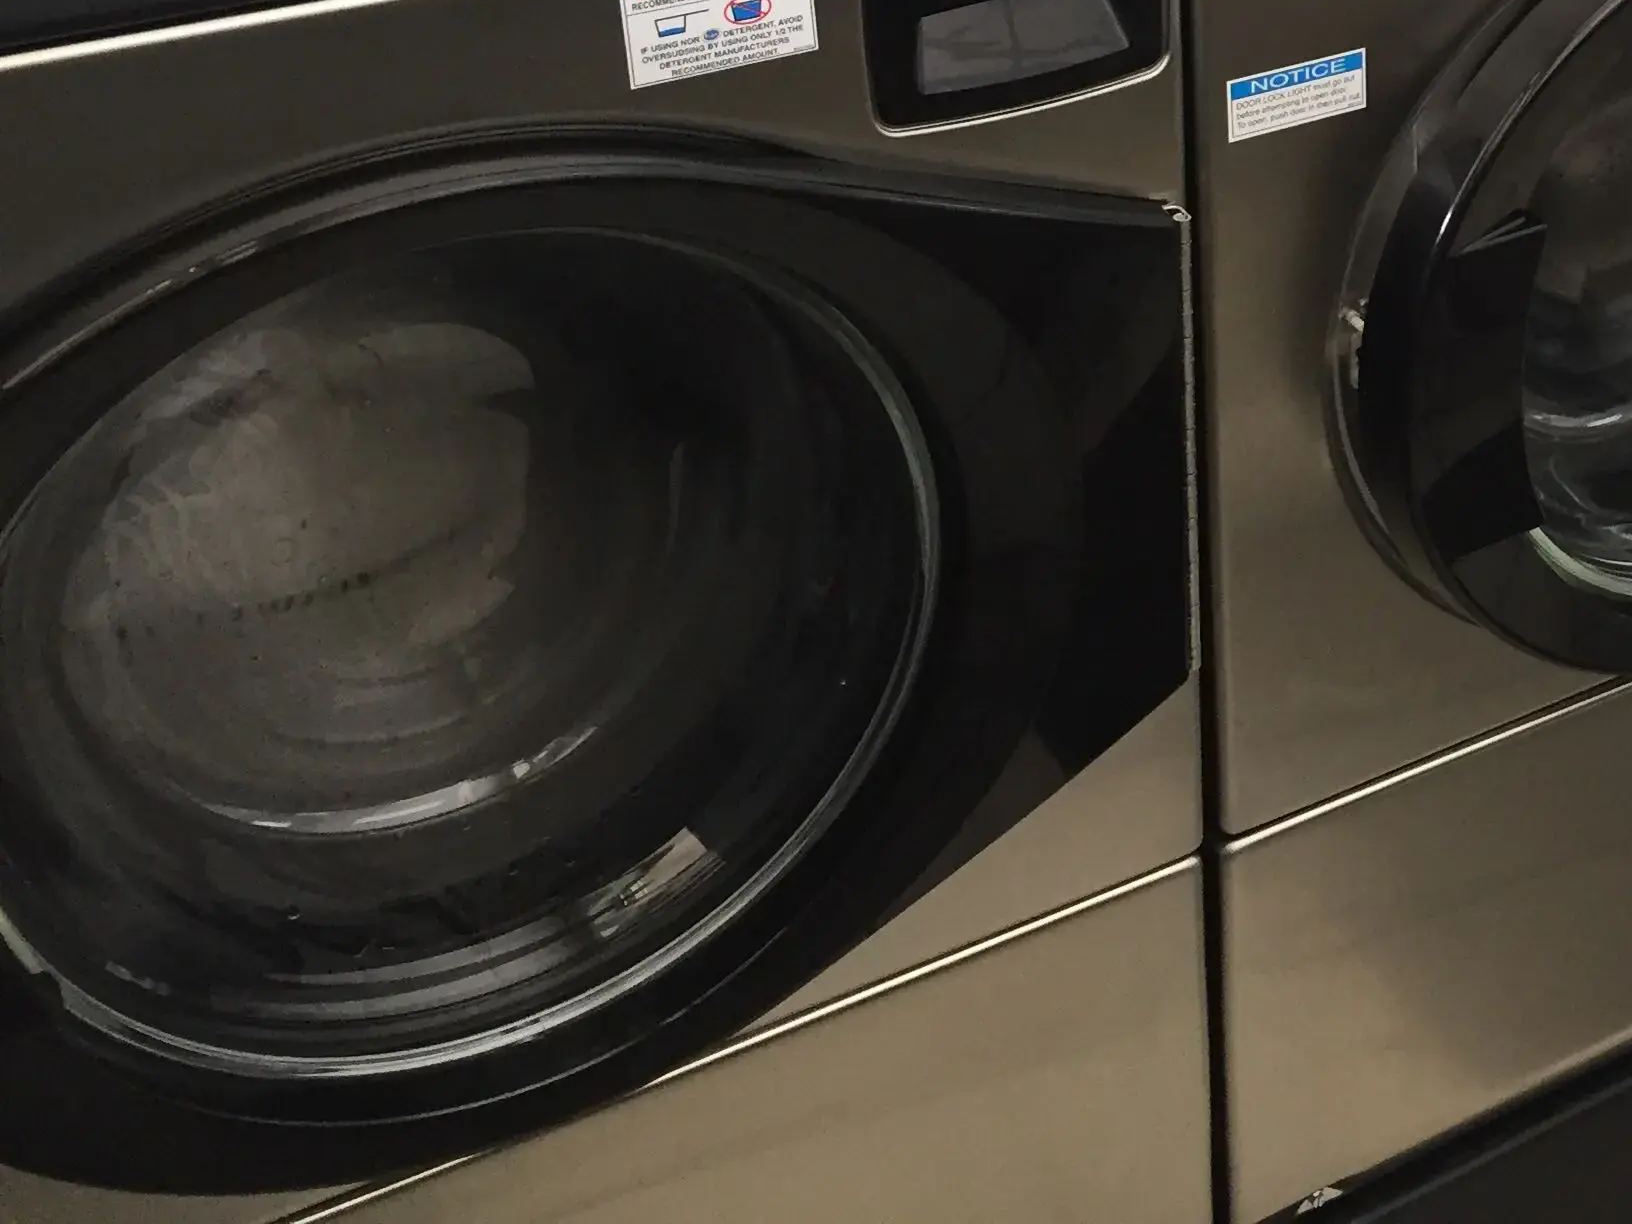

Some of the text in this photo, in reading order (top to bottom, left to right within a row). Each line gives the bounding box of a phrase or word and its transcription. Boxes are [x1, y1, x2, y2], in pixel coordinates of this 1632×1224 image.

[777, 14, 803, 25] AVOID
[641, 44, 705, 64] OVERSUDSING
[707, 41, 718, 50] BY
[720, 35, 748, 47] USING
[749, 30, 772, 40] ONLY
[786, 24, 803, 32] THE
[650, 40, 678, 52] USING
[659, 36, 789, 69] DETERGENT MANUFACTURERS
[671, 56, 740, 76] RECOMMENDED
[1251, 59, 1346, 93] NOTICE
